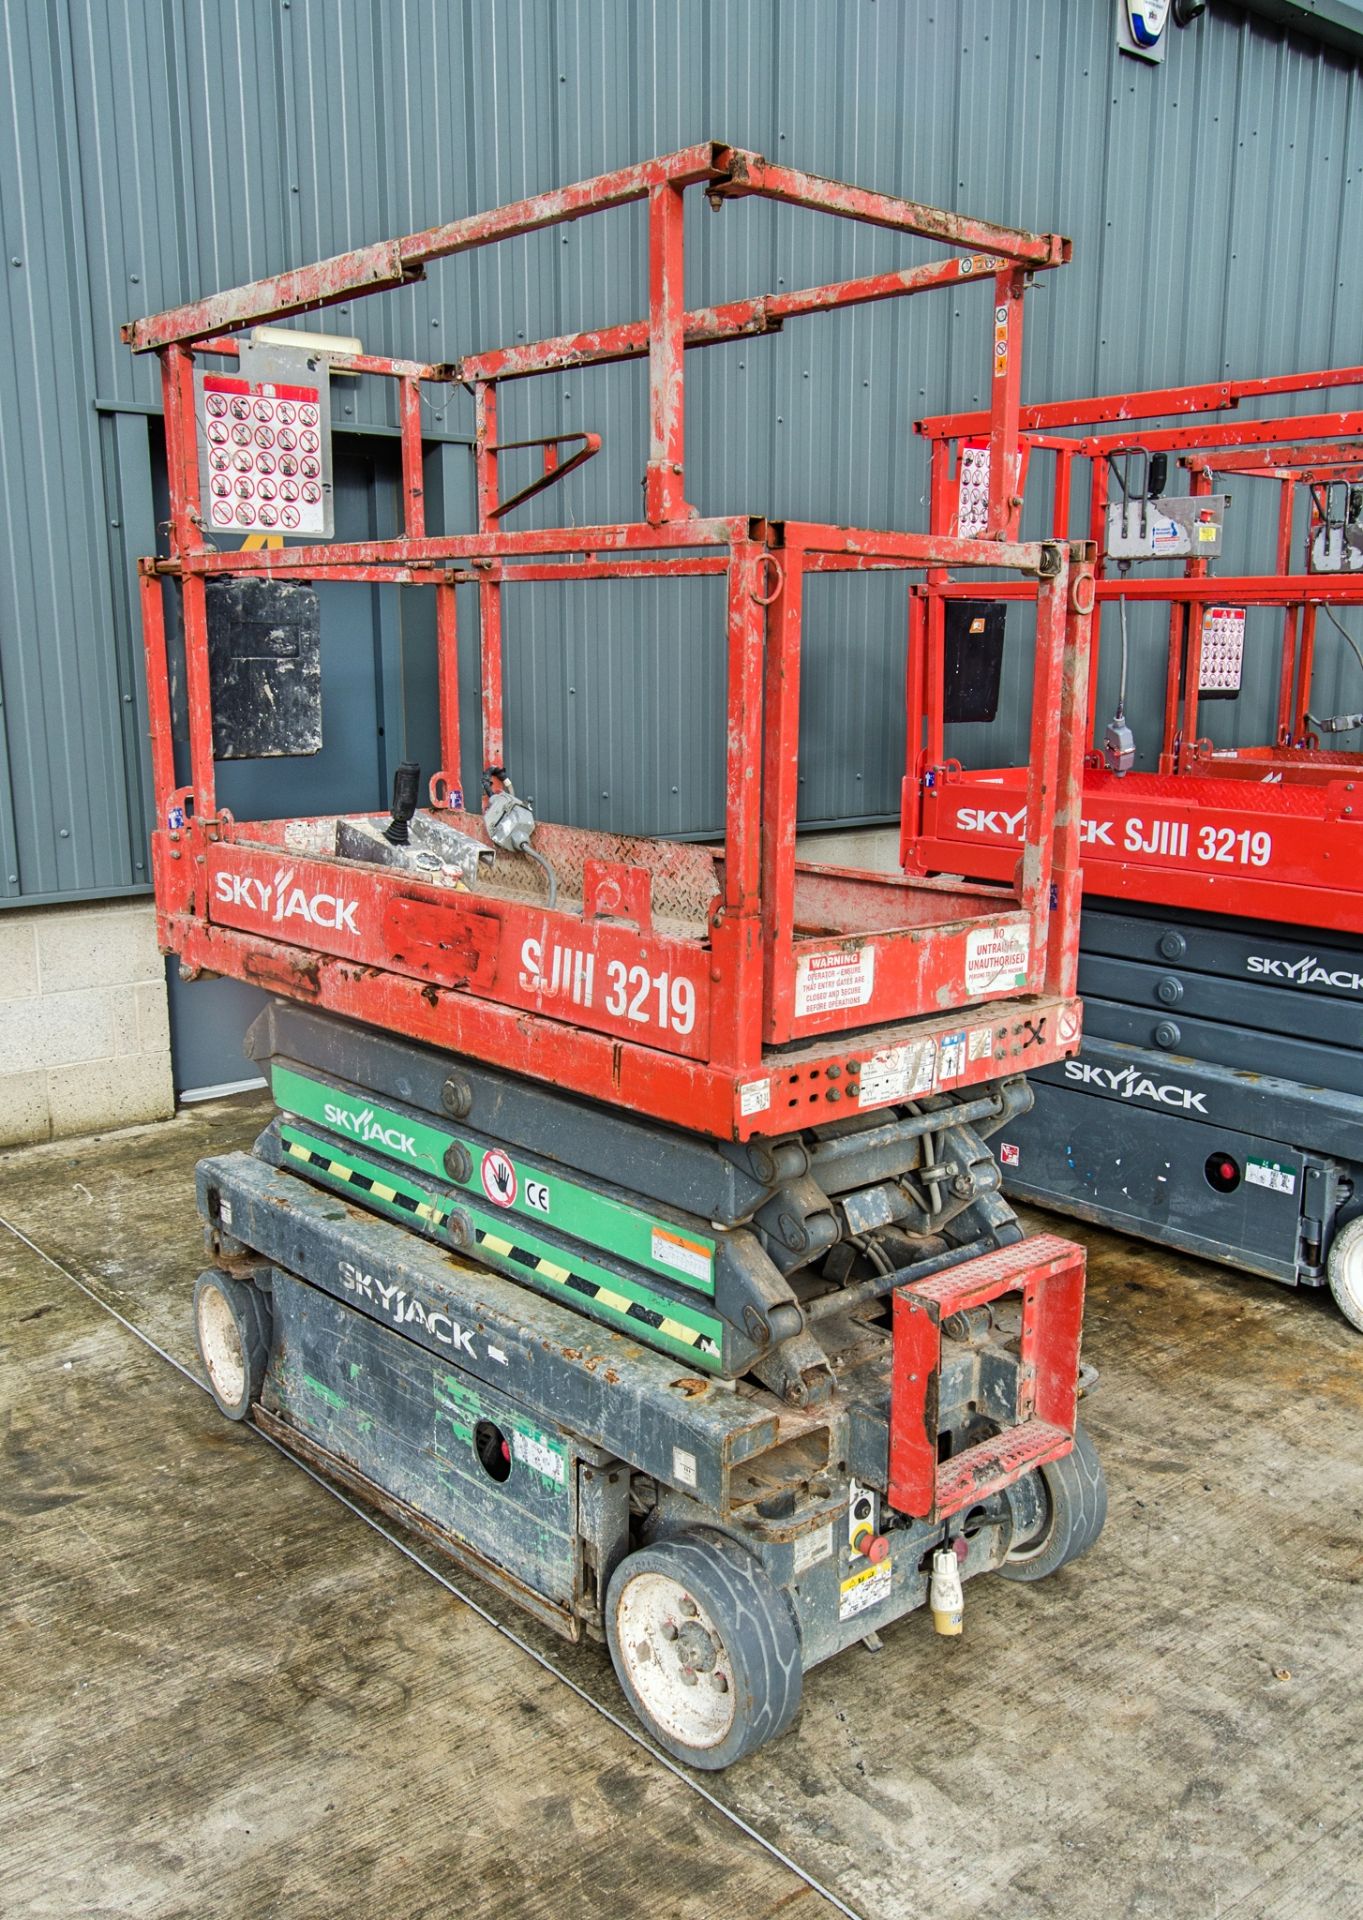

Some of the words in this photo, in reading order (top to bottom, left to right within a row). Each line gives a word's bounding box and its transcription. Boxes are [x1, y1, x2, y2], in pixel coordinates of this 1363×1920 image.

[1197, 826, 1272, 866] 3219
[215, 866, 361, 935] SKYJACK
[993, 928, 1005, 939] NO
[811, 953, 858, 969] WARNING
[968, 953, 1026, 971] UNAUTHORISED
[605, 960, 696, 1034] 3219
[1064, 1061, 1209, 1114] SKYJACK
[324, 1103, 417, 1157] SKYJACK
[527, 1183, 547, 1210] CE
[338, 1261, 478, 1360] SKYJACK
